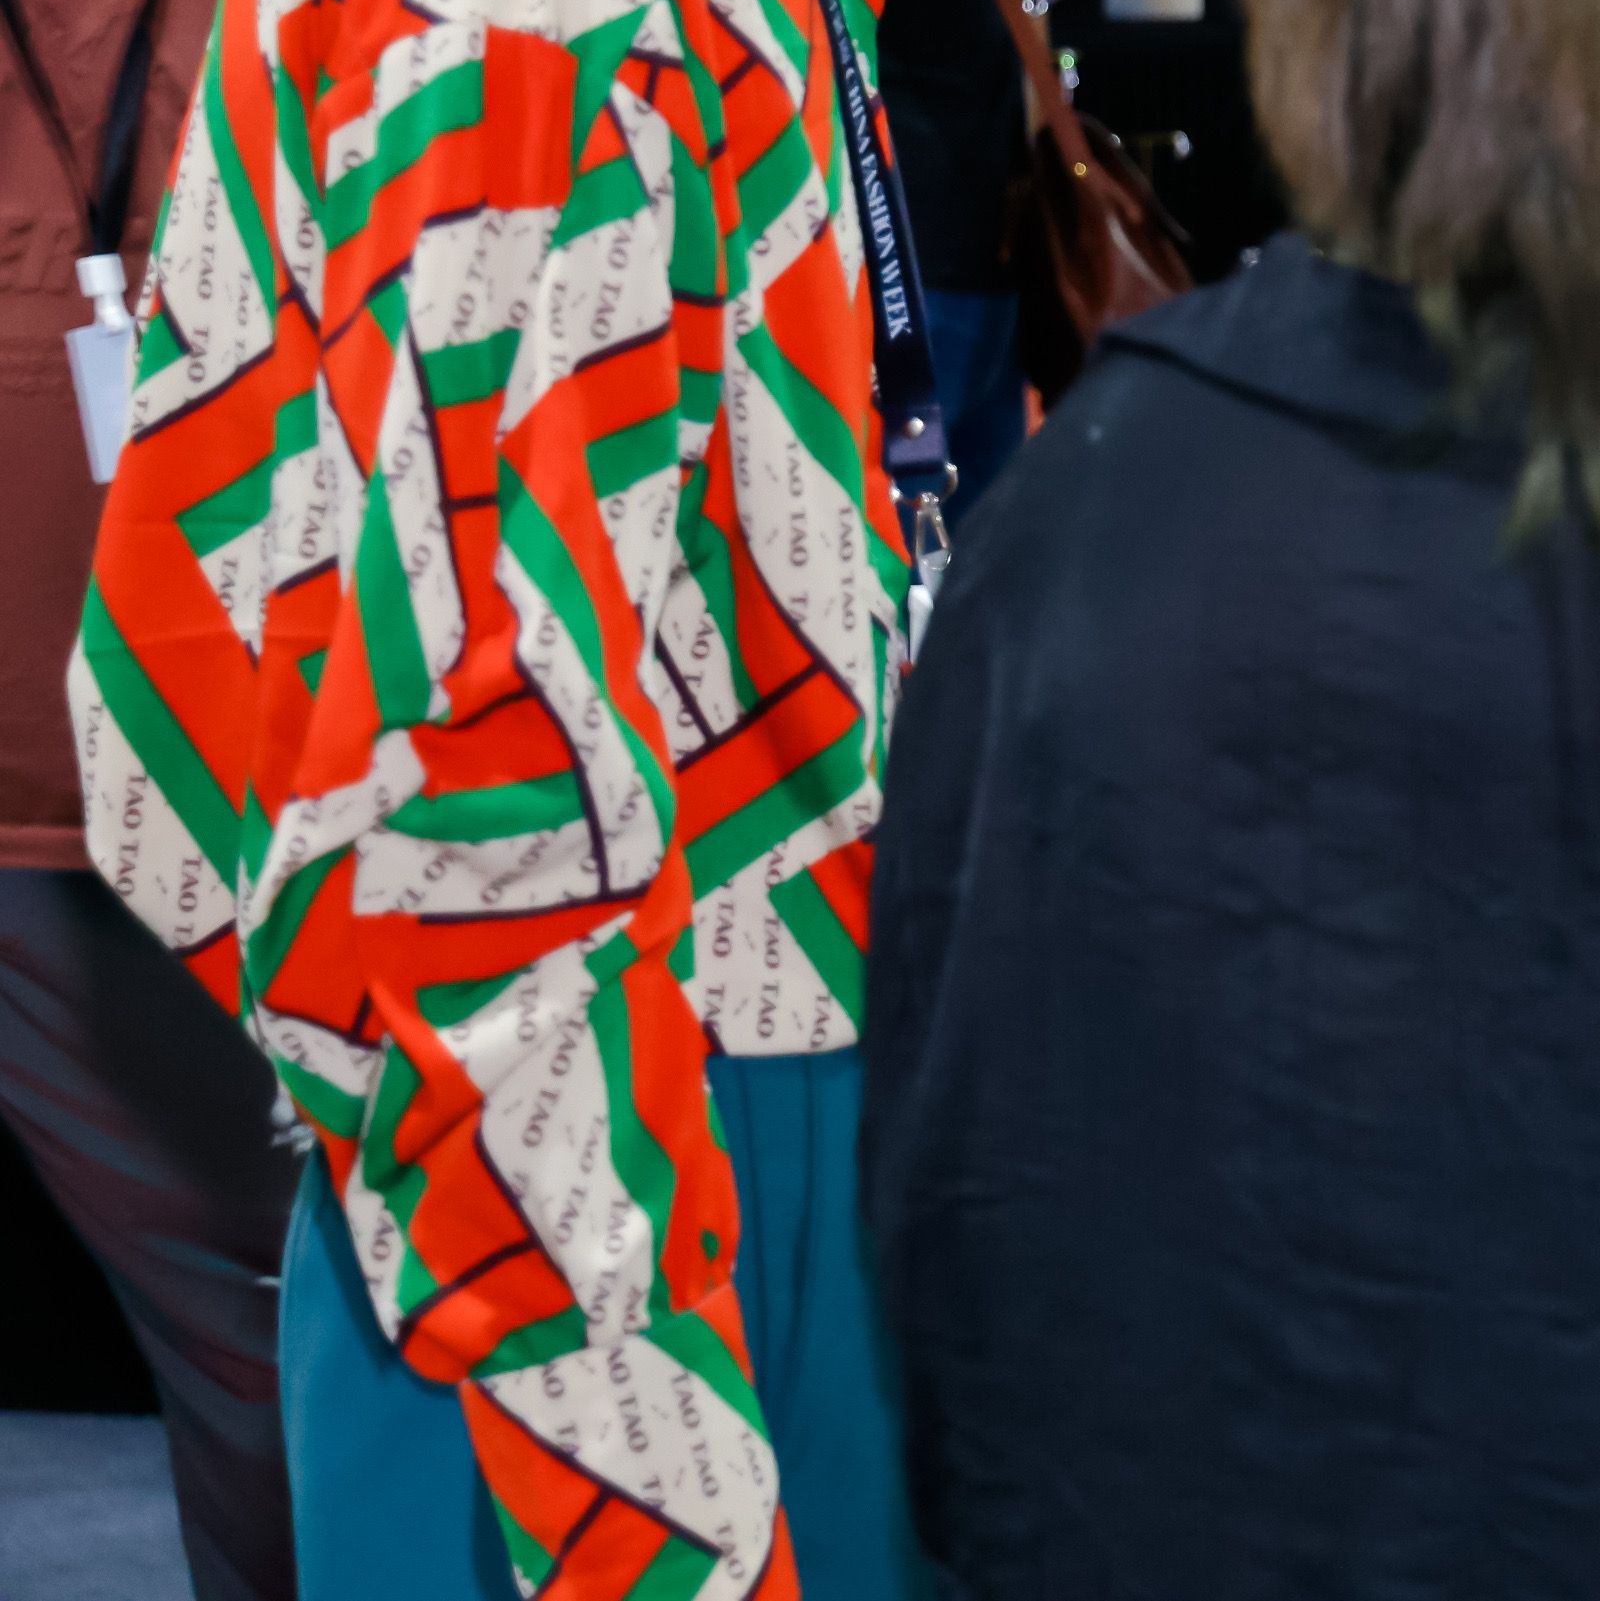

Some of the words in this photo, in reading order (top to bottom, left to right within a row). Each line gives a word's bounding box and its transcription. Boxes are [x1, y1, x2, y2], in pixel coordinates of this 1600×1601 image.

[203, 176, 220, 232] TAO
[199, 242, 215, 300] TAO
[236, 269, 250, 326] TAO
[879, 259, 912, 340] WEEK
[590, 280, 623, 341] TAO
[187, 326, 210, 383] TAO
[786, 442, 804, 497] TAO
[299, 501, 328, 560] TAO
[789, 511, 809, 567] TAO
[838, 506, 855, 562] TAO
[841, 576, 856, 632] TAO
[122, 775, 148, 830] TAO
[114, 842, 139, 898] TAO
[178, 857, 202, 914] TAO
[711, 899, 735, 958] TAO
[764, 917, 781, 970] TAO
[756, 981, 781, 1040] TAO
[810, 994, 831, 1050] TAO
[550, 1015, 588, 1077] TAO
[522, 1087, 561, 1149] TAO
[618, 1393, 649, 1454] TAO
[671, 1371, 701, 1430] TAO
[691, 1440, 720, 1498] TAO
